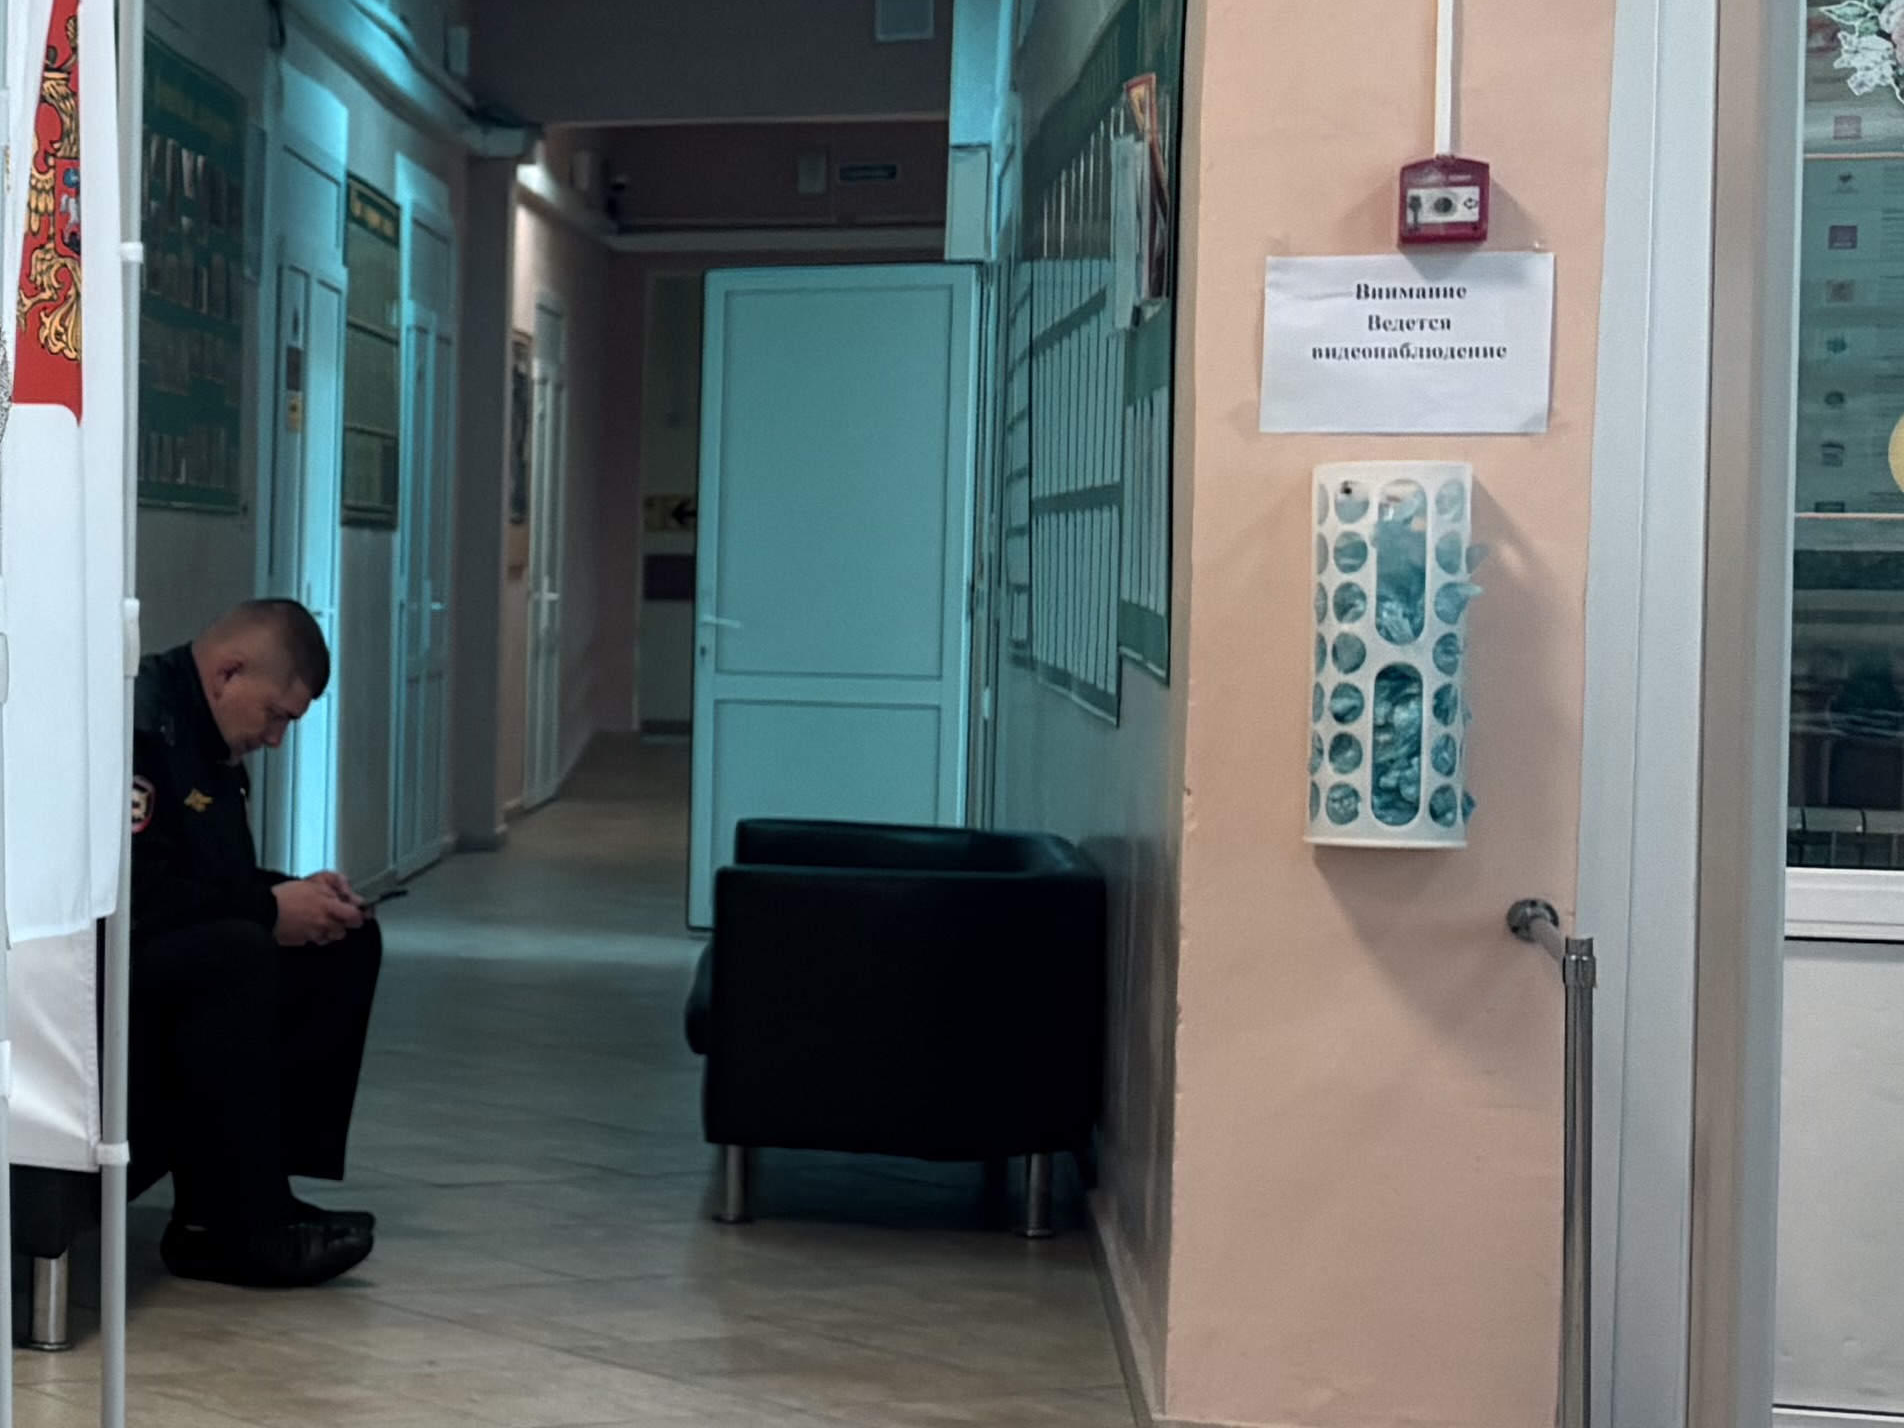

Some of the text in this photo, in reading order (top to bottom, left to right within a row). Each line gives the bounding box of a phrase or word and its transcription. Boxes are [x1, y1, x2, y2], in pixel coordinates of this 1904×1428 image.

[1356, 283, 1467, 301] Внимание
[1367, 314, 1452, 333] Ведется
[1311, 342, 1507, 362] видеонаблюдение
